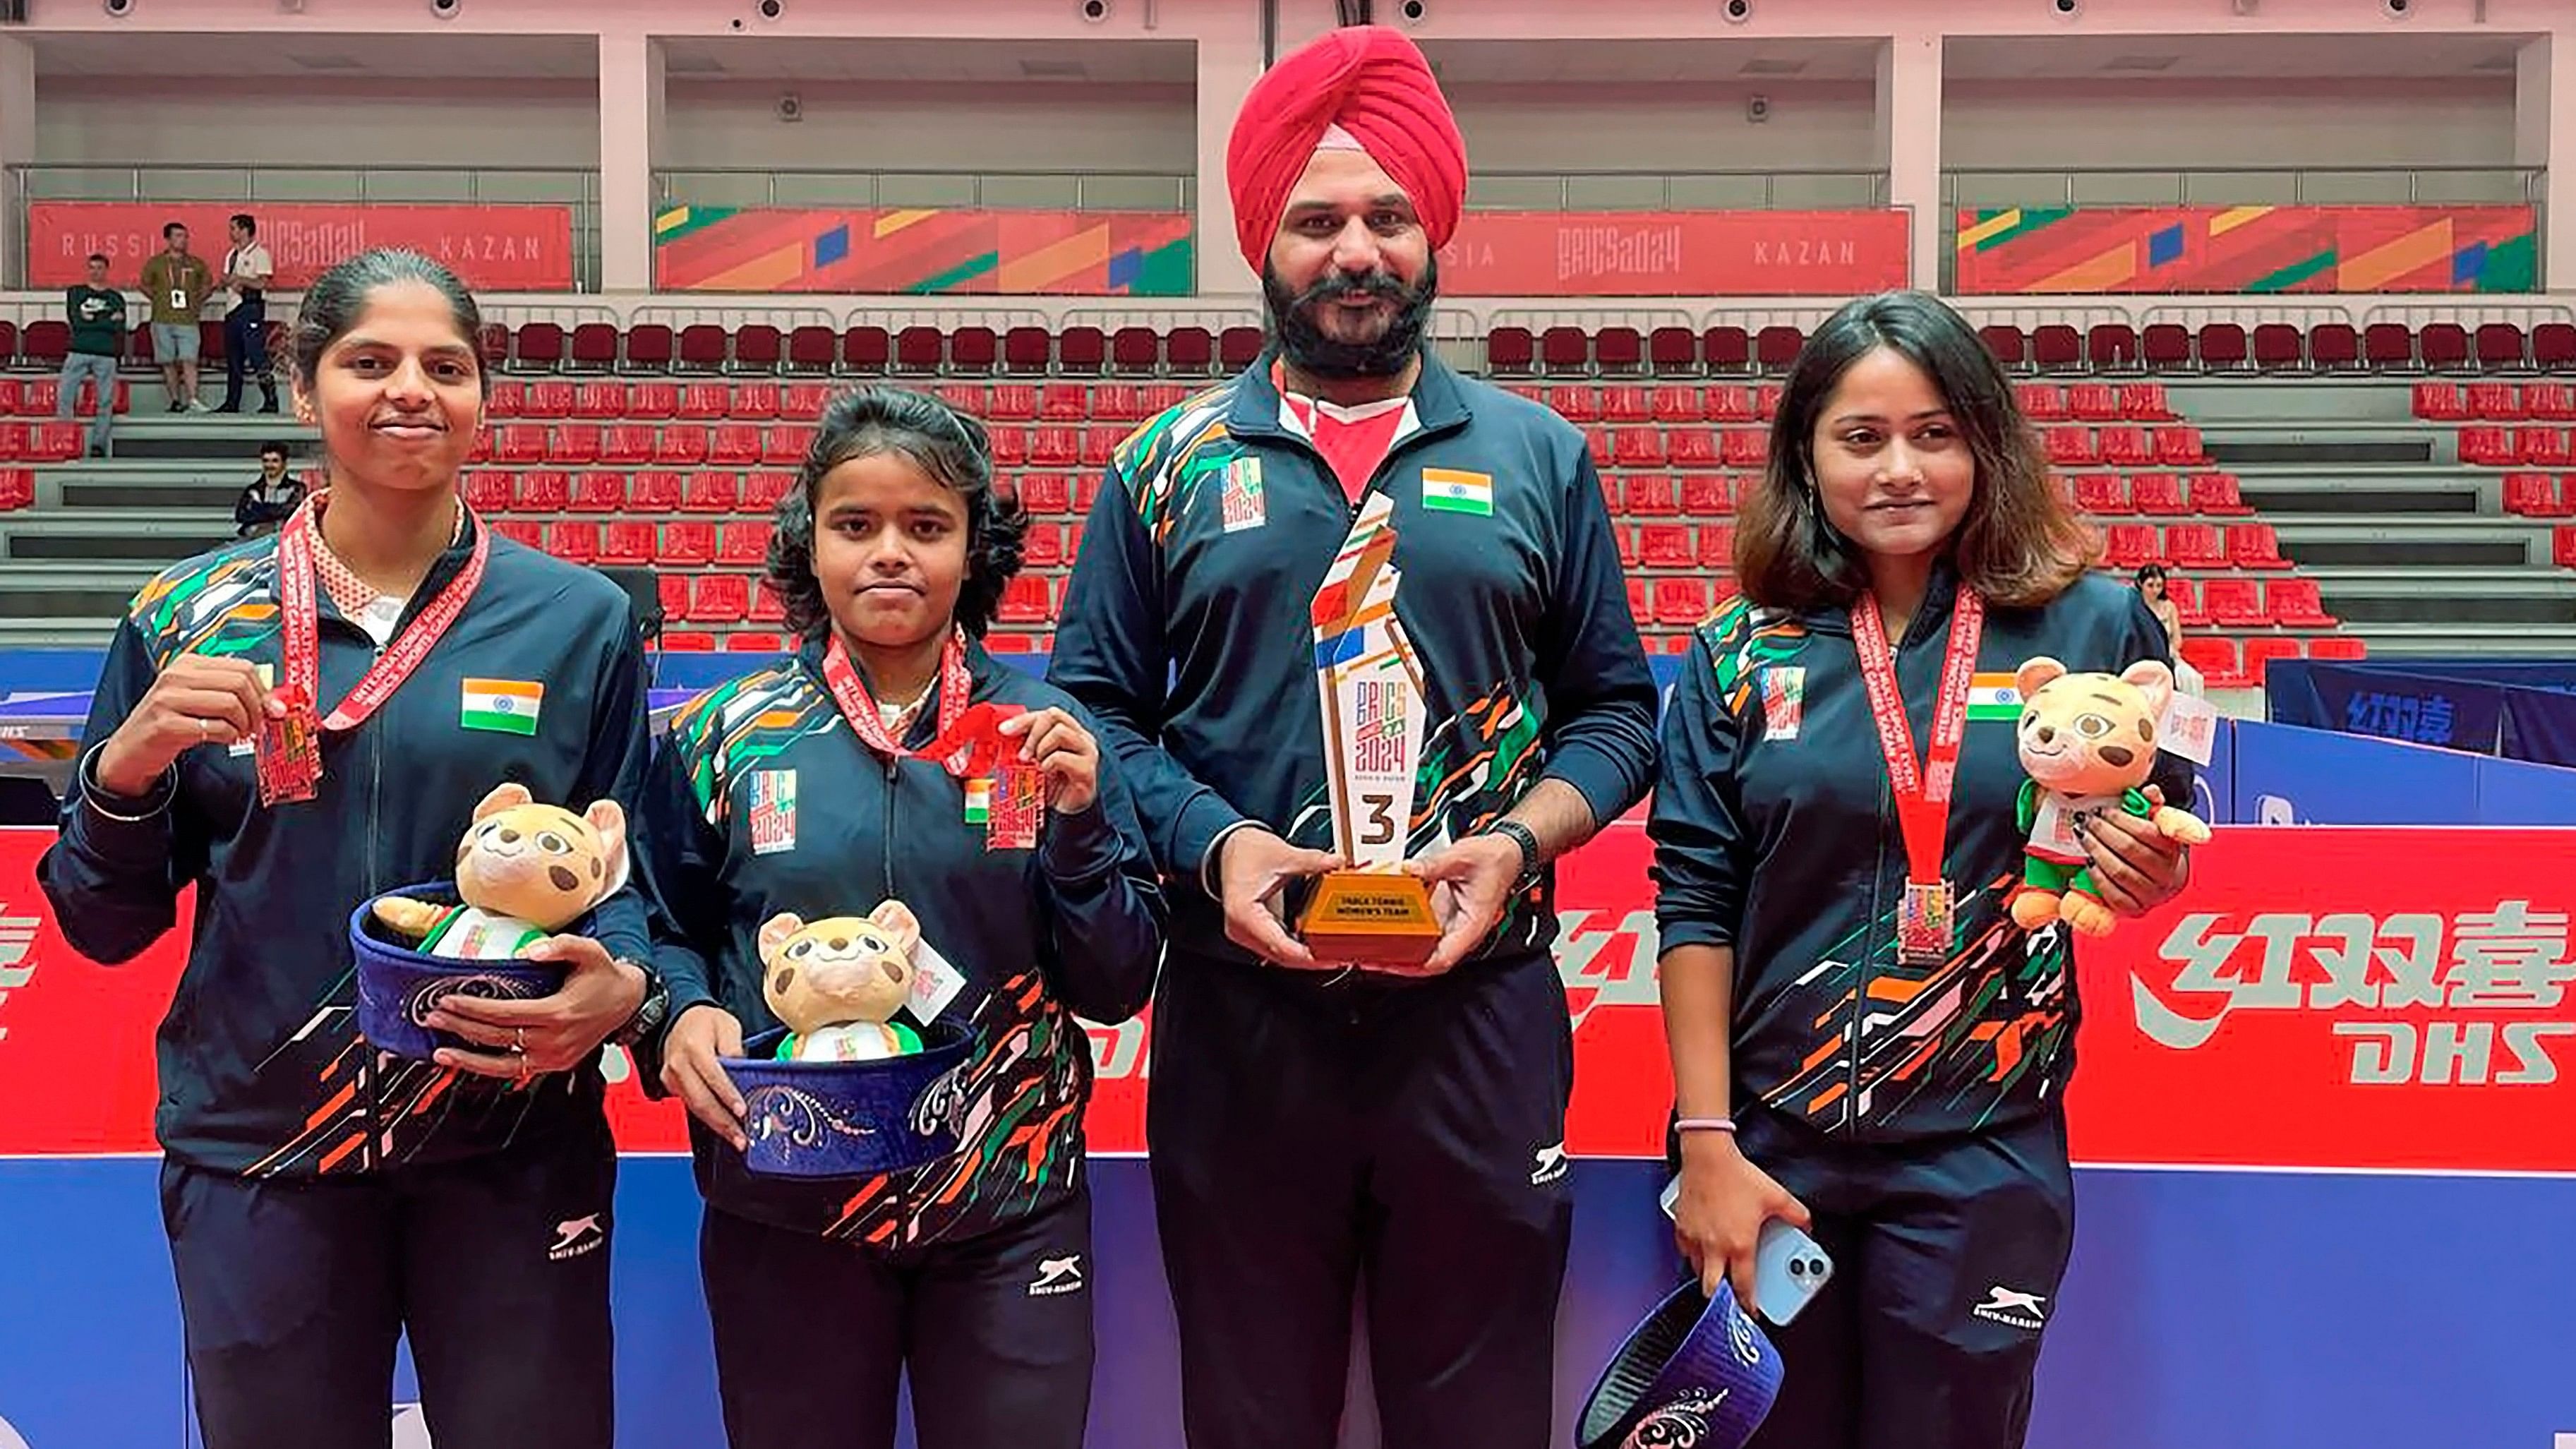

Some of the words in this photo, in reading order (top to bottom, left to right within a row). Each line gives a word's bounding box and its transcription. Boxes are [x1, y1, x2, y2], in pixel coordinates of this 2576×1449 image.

[62, 233, 155, 256] RUSSI
[440, 235, 539, 260] KAZAN
[1755, 241, 1854, 265] KAZAN
[1356, 681, 1406, 726] BRICS
[1355, 735, 1405, 772] 2024
[1361, 795, 1395, 844] 3
[2153, 900, 2576, 1009] 红双喜
[2331, 1021, 2576, 1085] DHS
